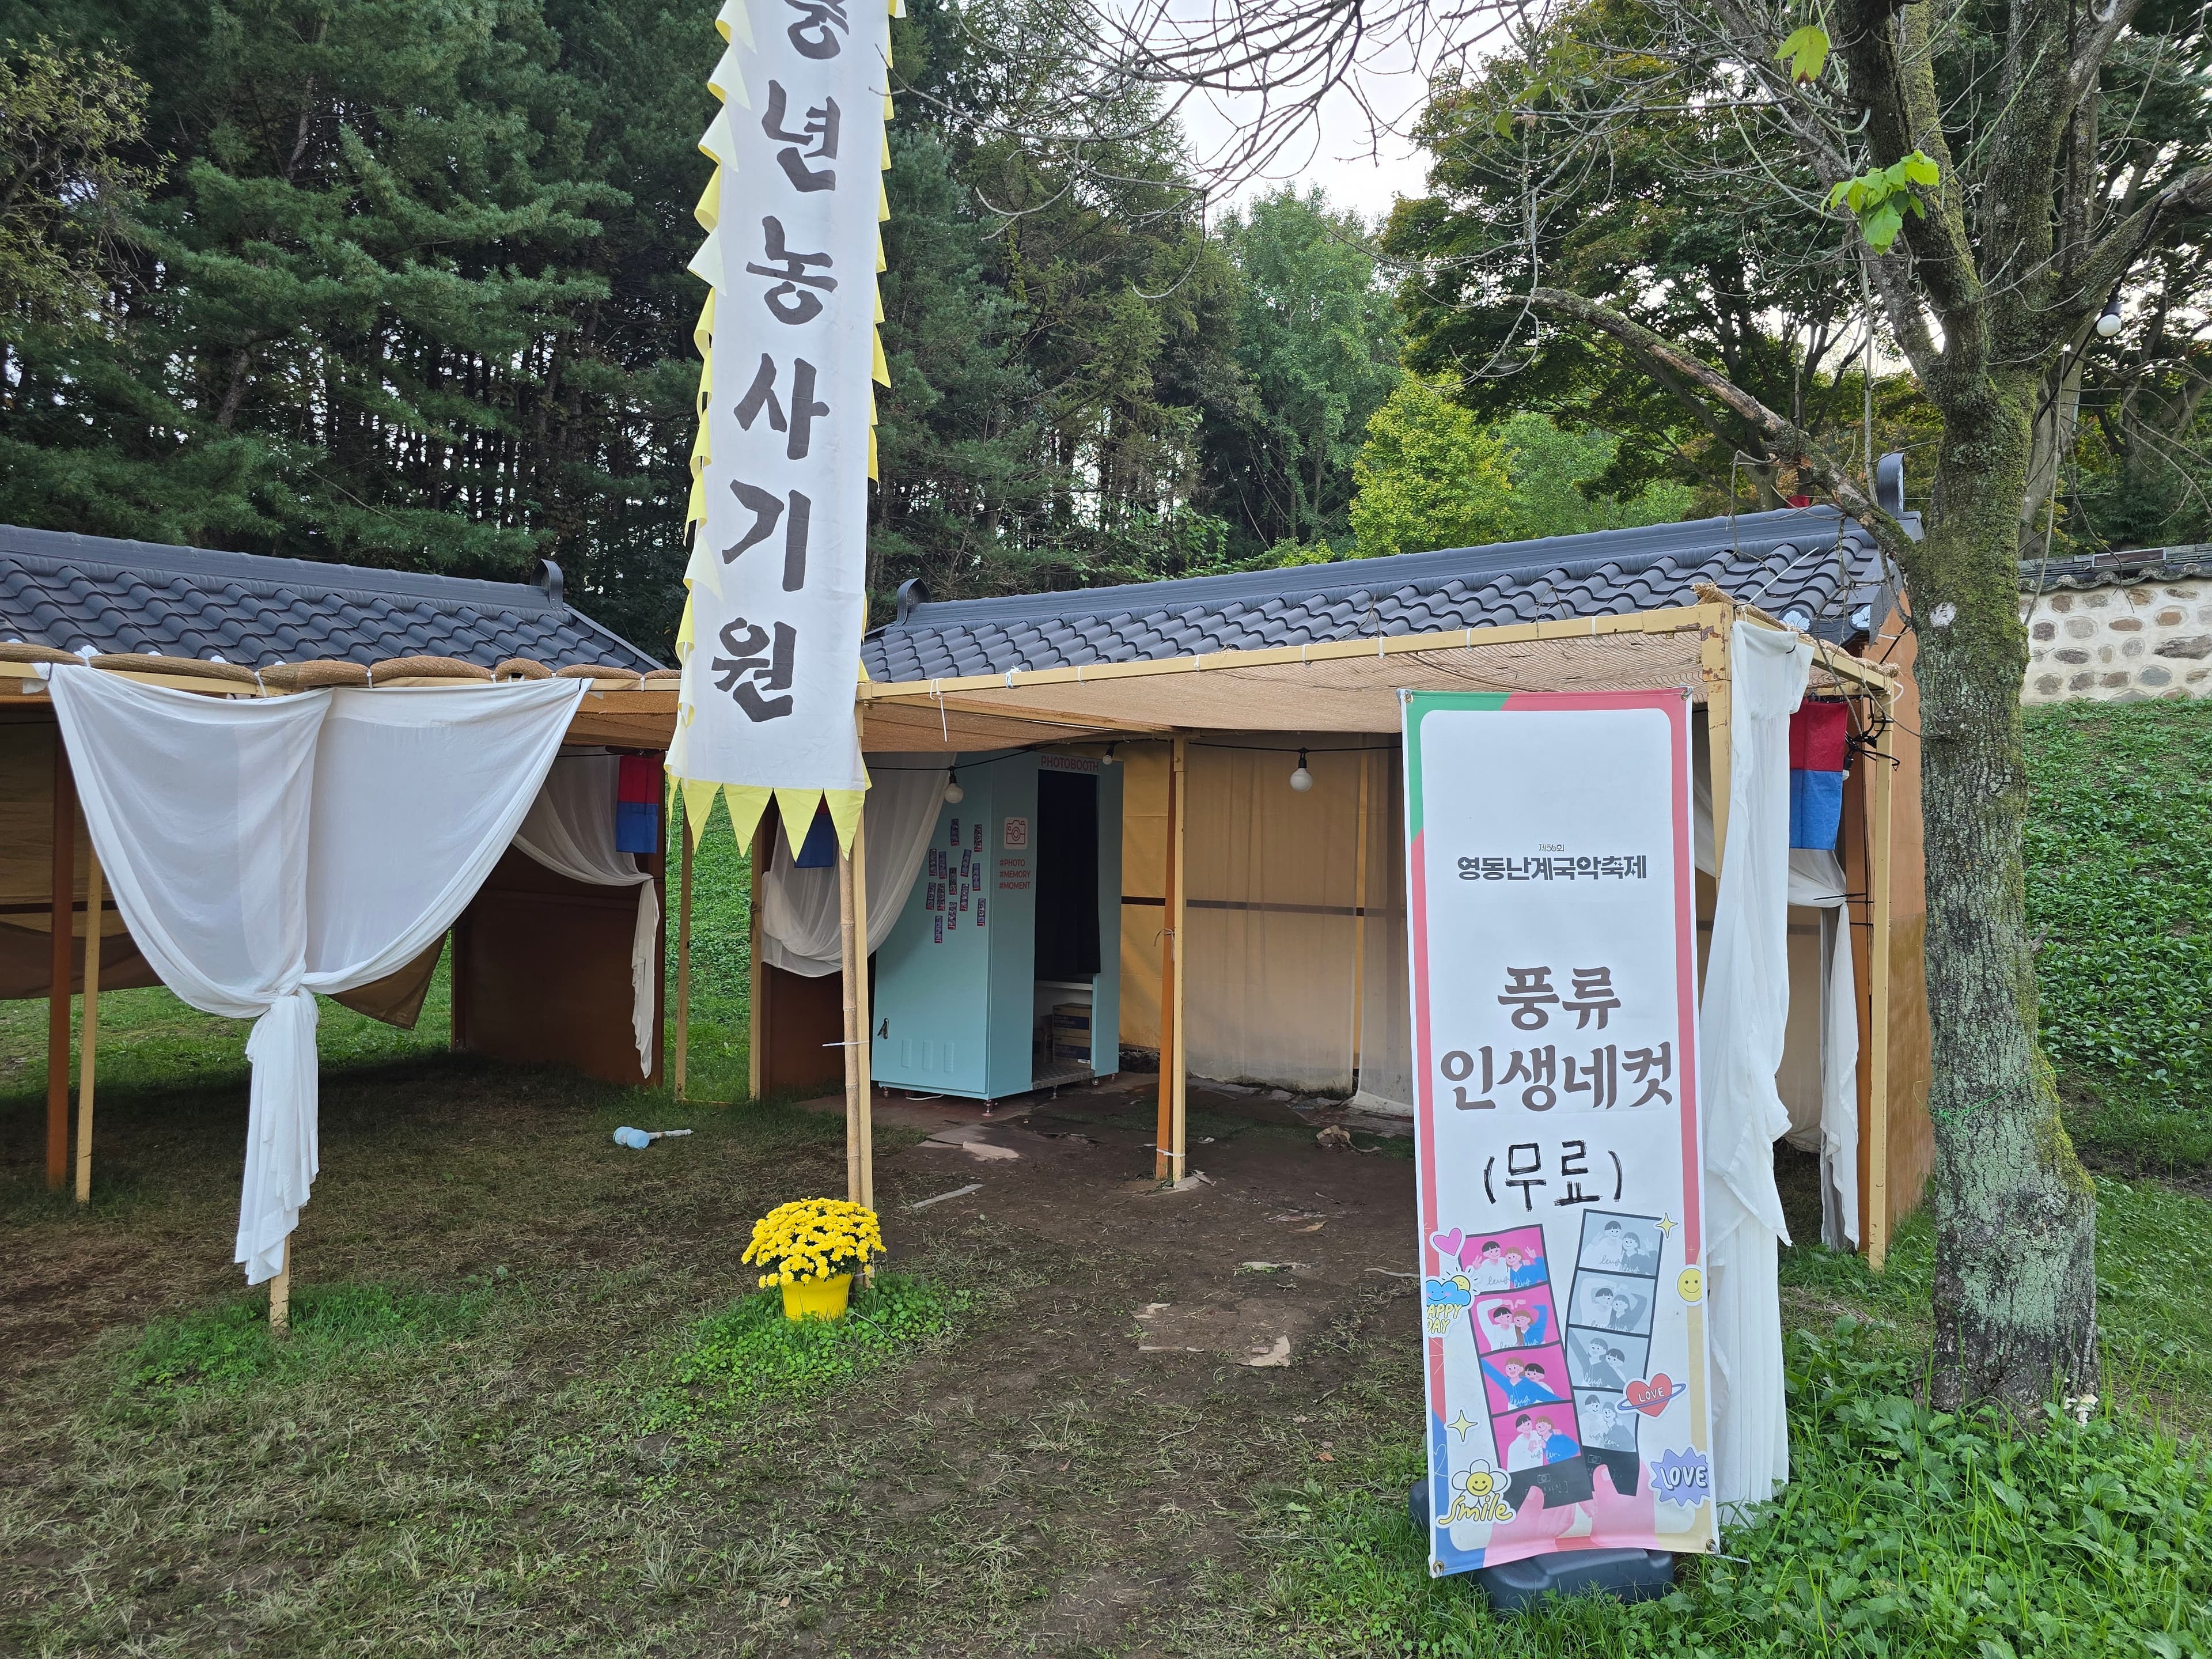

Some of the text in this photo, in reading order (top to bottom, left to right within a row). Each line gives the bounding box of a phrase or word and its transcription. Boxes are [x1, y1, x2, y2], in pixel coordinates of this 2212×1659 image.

[1041, 755, 1099, 771] PHOTOBOOTH
[1539, 844, 1565, 852] 제56회
[999, 859, 1025, 867] #PHOTO
[1457, 855, 1647, 881] 영동난계국악축제
[999, 870, 1031, 878] #MEMORY
[999, 881, 1031, 890] #MOMENT
[1498, 966, 1622, 1031] 풍류
[1440, 1041, 1674, 1112] 인생네컷
[1483, 1140, 1623, 1212] (무료)
[1427, 1303, 1463, 1319] APPY
[1638, 1387, 1665, 1402] LOVE
[1660, 1465, 1708, 1491] LOVE
